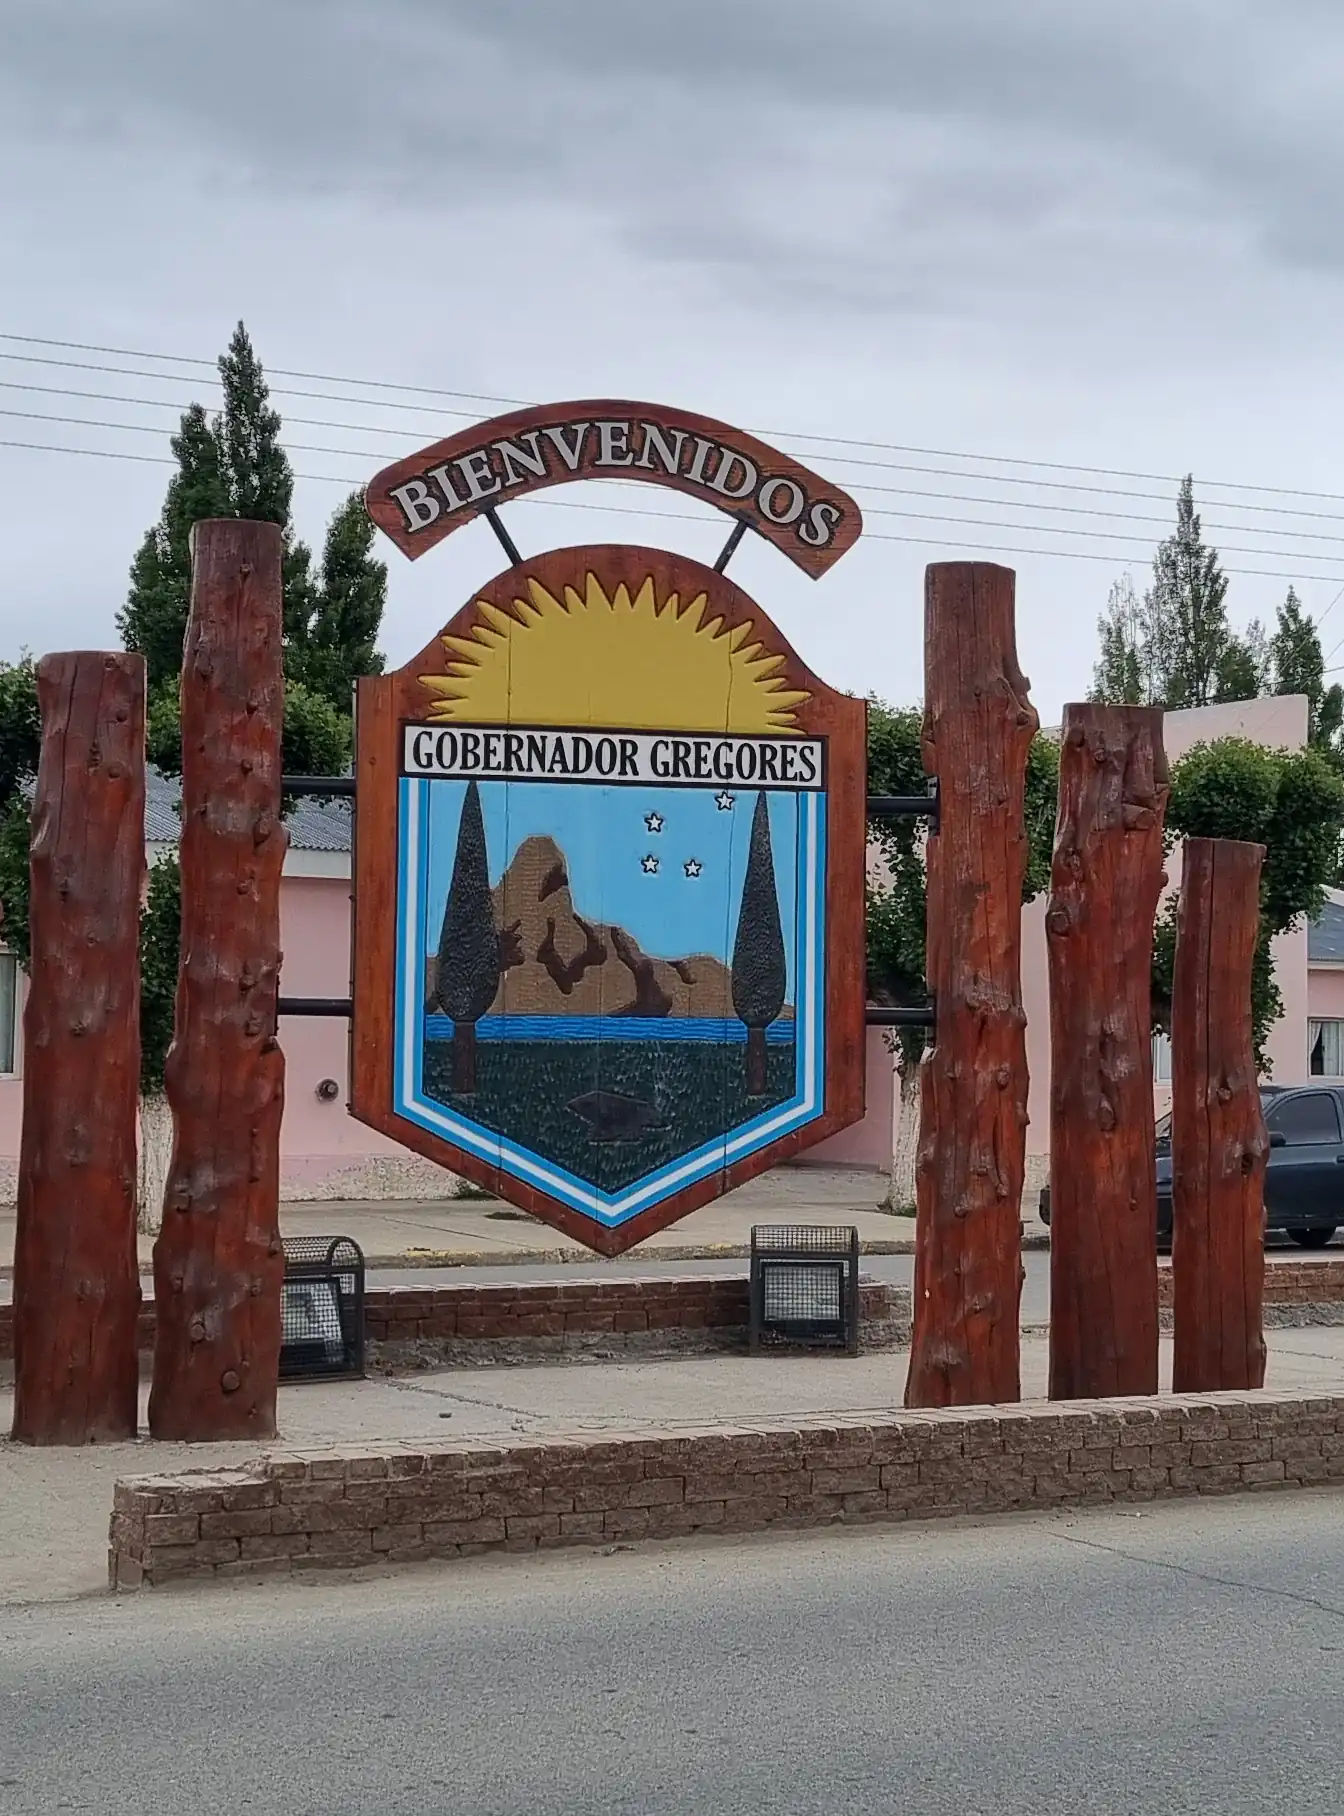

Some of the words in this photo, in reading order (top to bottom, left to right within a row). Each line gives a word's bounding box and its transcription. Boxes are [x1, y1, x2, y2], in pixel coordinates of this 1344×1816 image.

[390, 421, 841, 546] BIENVENIDOS
[412, 731, 638, 777] GOBERNADOR
[650, 736, 816, 783] GREGORES
